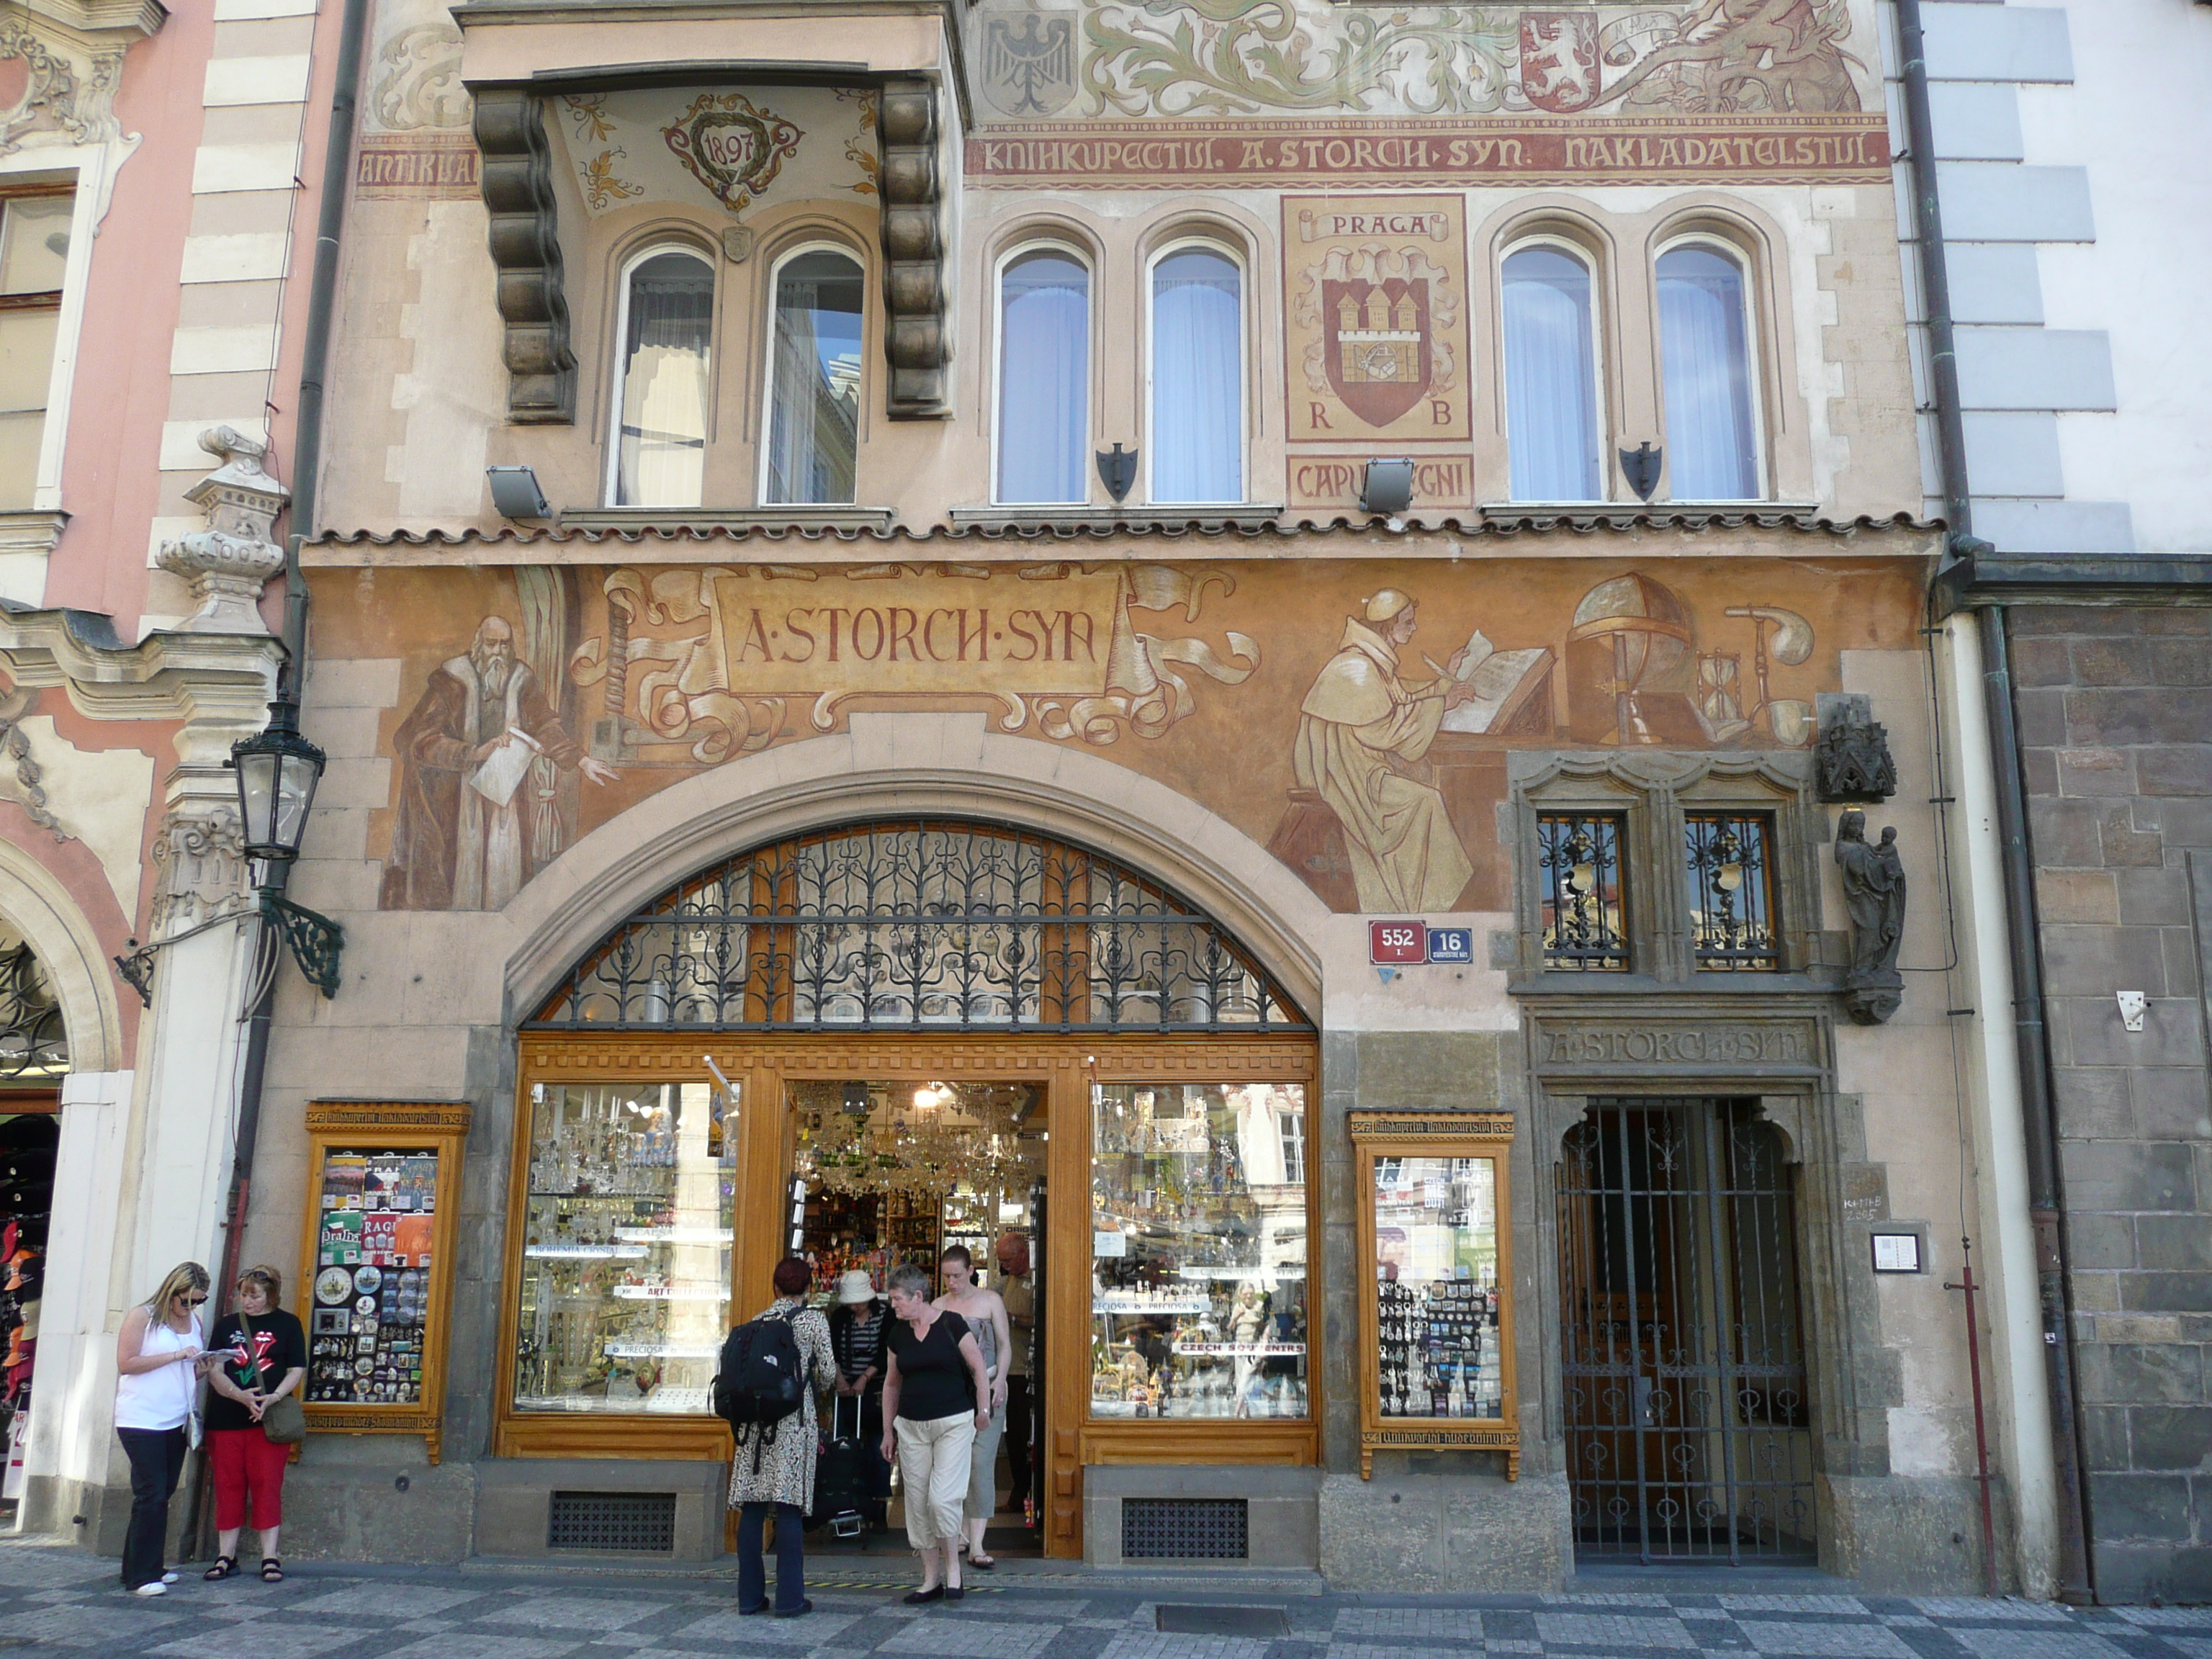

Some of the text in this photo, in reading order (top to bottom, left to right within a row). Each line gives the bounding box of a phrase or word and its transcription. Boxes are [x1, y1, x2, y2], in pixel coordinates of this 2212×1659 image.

[705, 132, 753, 165] 1897
[1278, 139, 1431, 170] STORCH
[359, 153, 480, 184] ANTIKVA
[1333, 216, 1429, 233] PRAGA
[1309, 401, 1452, 429] R B
[1297, 464, 1466, 498] CAPU EGNI
[1382, 929, 1415, 946] 552
[1439, 933, 1461, 950] 16
[1462, 1172, 1491, 1182] CZEC
[1424, 1185, 1445, 1197] ME
[1425, 1198, 1445, 1208] OUT!
[1846, 1209, 1877, 1221] 2005
[536, 1245, 621, 1254] BOHEMIA CRYSTAL
[624, 1345, 663, 1354] PRECIOSA
[1228, 1344, 1305, 1352] SOUENIRS
